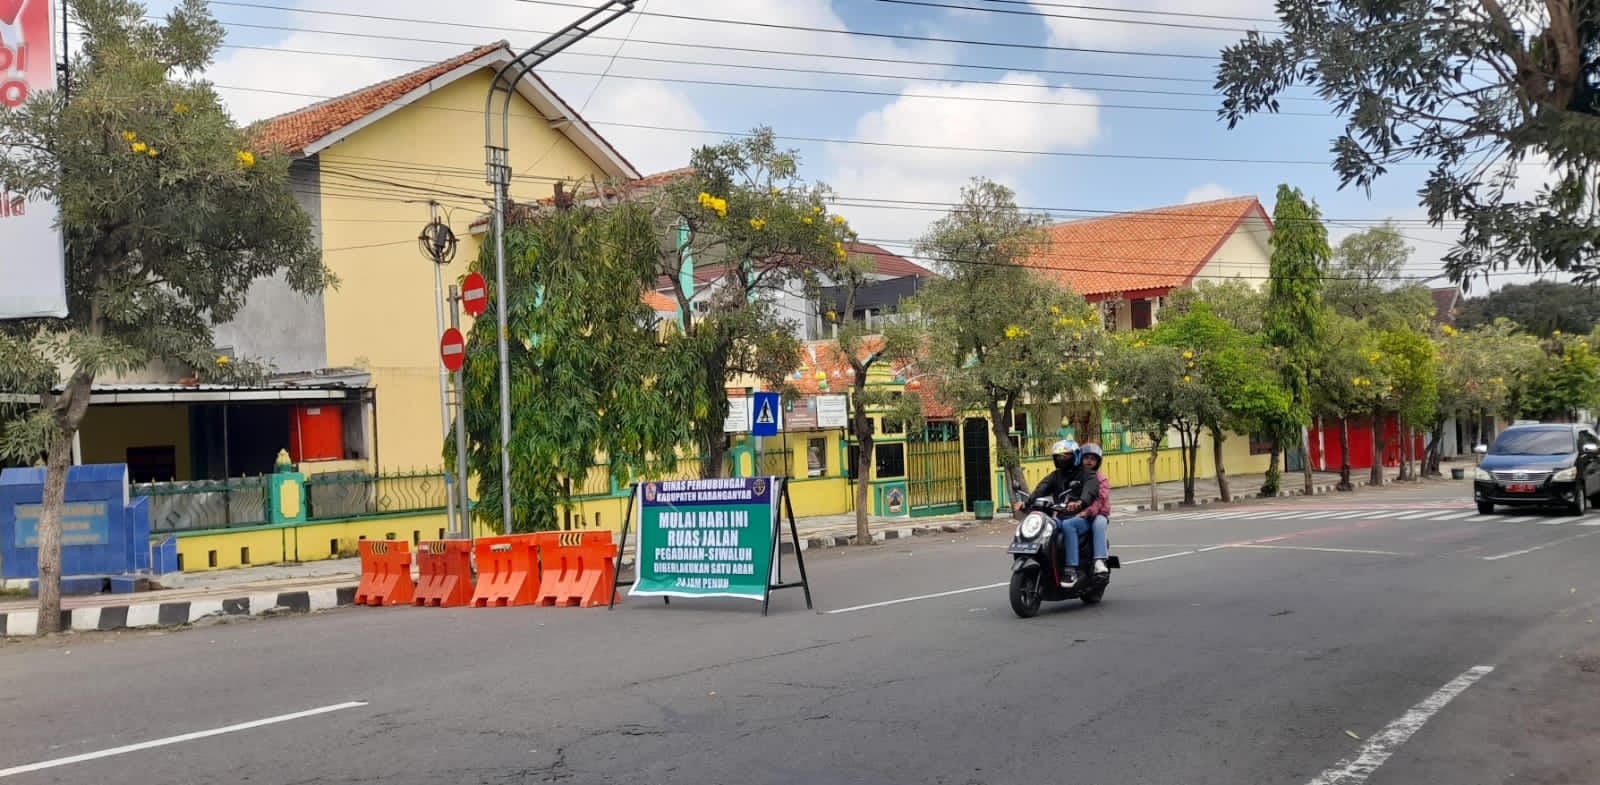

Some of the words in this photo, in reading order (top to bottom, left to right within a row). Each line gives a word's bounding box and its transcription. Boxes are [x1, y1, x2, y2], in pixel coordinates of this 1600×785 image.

[662, 480, 686, 492] DINAS
[687, 478, 746, 491] PERHUBUNGAN
[656, 491, 697, 503] KABUPATEN
[697, 489, 752, 501] KARANGANYAR
[659, 511, 696, 529] MULAI
[698, 511, 728, 528] HARI
[730, 510, 748, 528] INI
[667, 530, 700, 547] RUAS
[701, 530, 739, 547] JALAN
[655, 547, 753, 561] PEGADAIAN-SIWALUH
[653, 562, 710, 574] DIBERLAKUKAN
[711, 562, 731, 574] SATU
[732, 563, 754, 575] ARAH
[686, 577, 702, 588] JAM
[702, 578, 729, 589] PENUH
